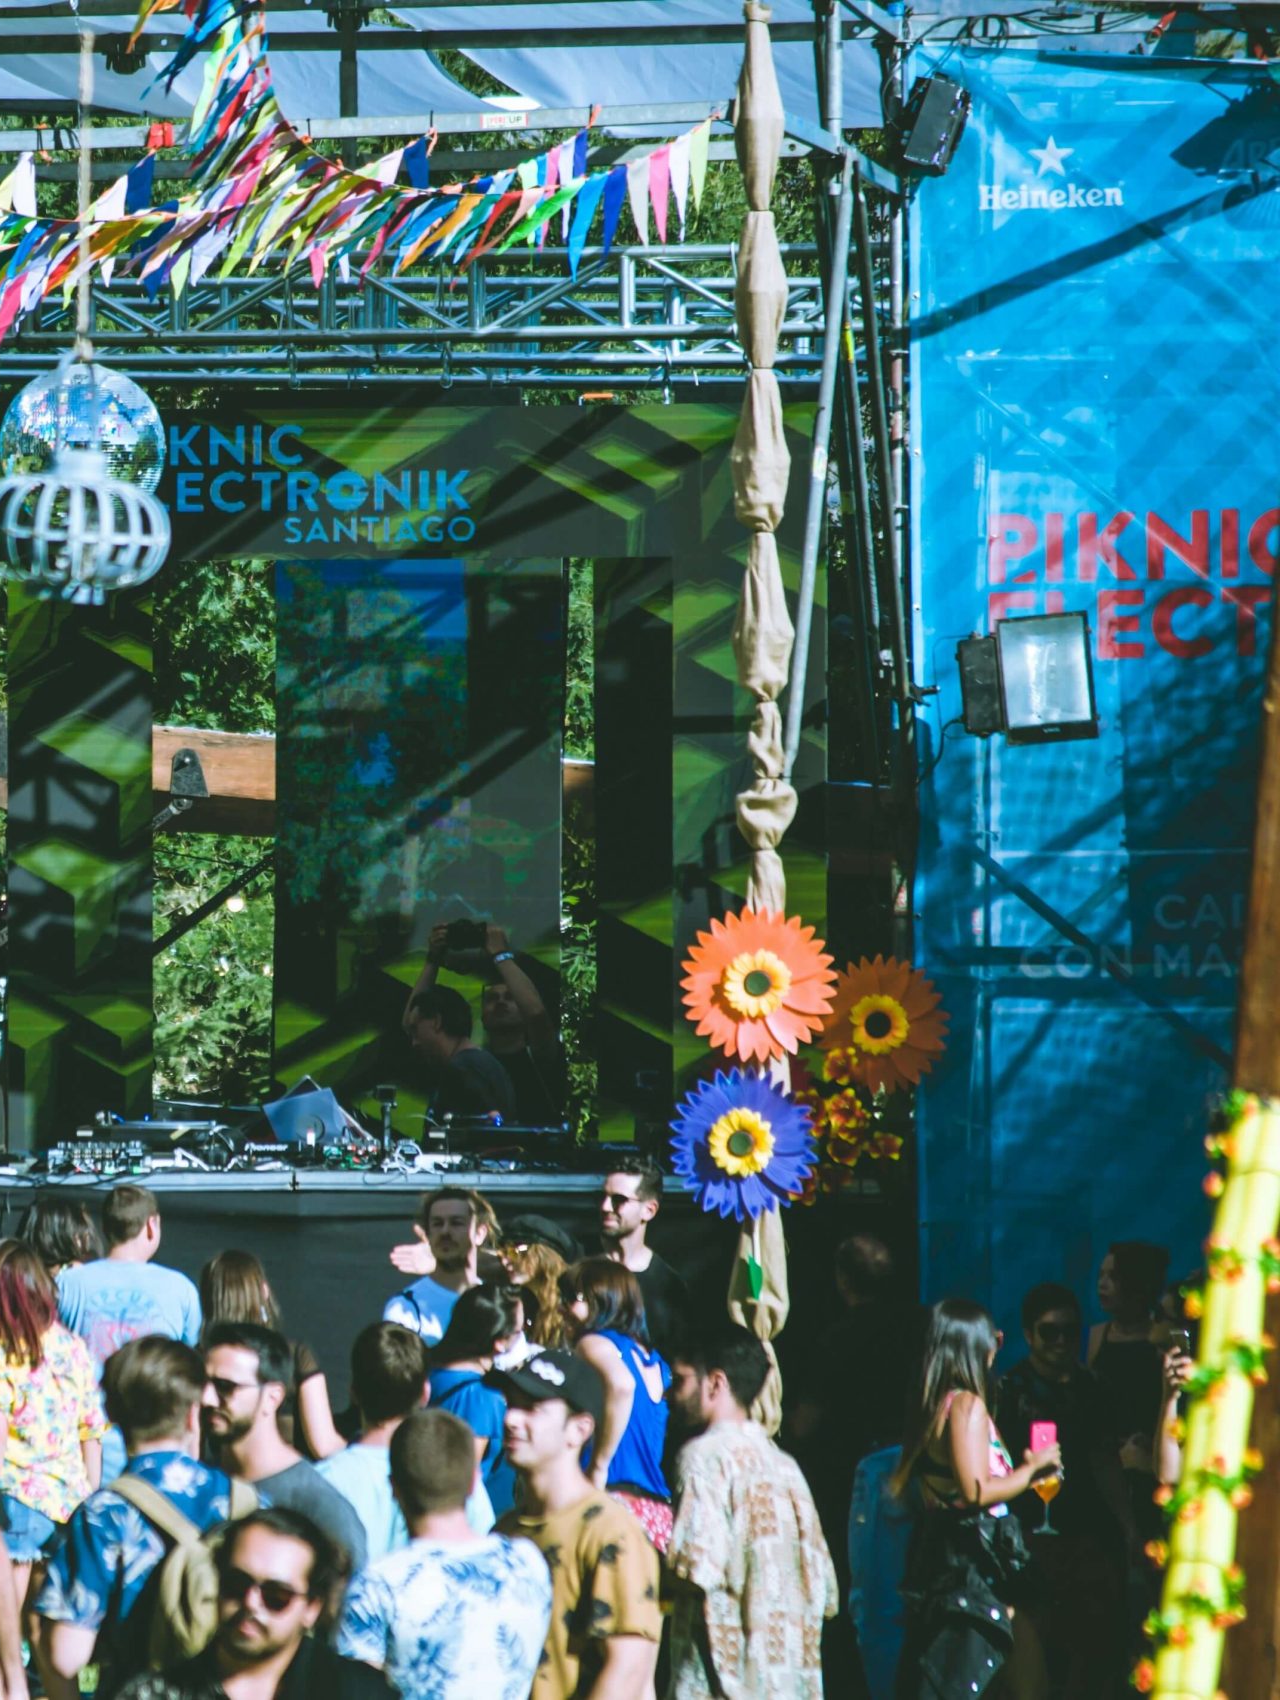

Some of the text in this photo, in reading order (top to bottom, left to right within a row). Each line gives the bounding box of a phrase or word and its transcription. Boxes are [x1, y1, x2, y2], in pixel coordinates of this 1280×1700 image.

[979, 183, 1124, 210] Heineken
[170, 425, 303, 466] KNIC
[164, 470, 470, 513] ECTRONIK
[285, 516, 476, 543] SANTIAGO
[988, 588, 1271, 661] ECT
[1154, 893, 1245, 930] CA
[1020, 931, 1242, 979] CON MÁ
